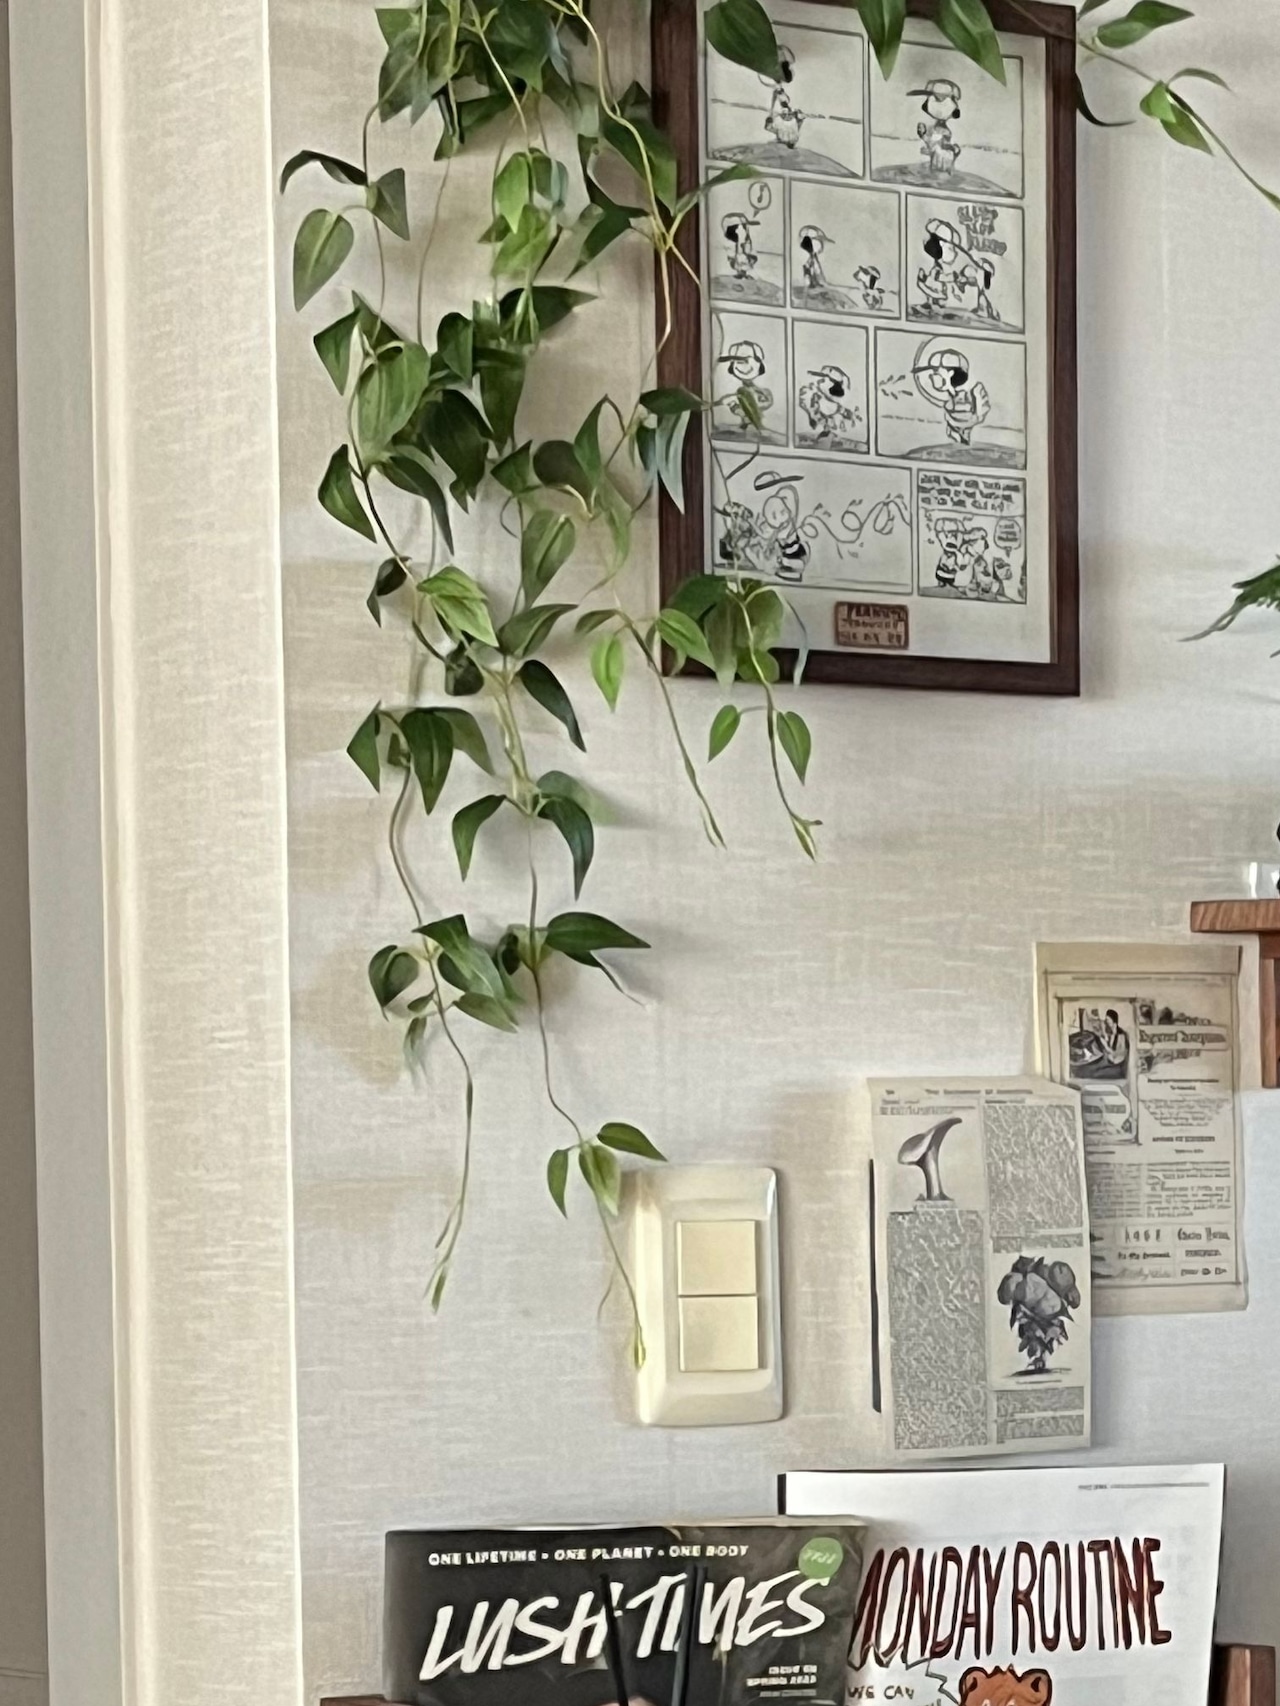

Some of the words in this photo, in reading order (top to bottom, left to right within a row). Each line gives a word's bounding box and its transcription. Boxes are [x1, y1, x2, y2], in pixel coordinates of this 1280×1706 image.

[428, 1553, 461, 1566] ONE
[466, 1550, 537, 1565] LIFETIME
[554, 1548, 587, 1561] ONE
[591, 1546, 654, 1560] PLANET
[669, 1545, 701, 1557] ONE
[706, 1545, 749, 1557] BODY
[1011, 1537, 1172, 1655] ROUTINE
[847, 1685, 875, 1699] WE
